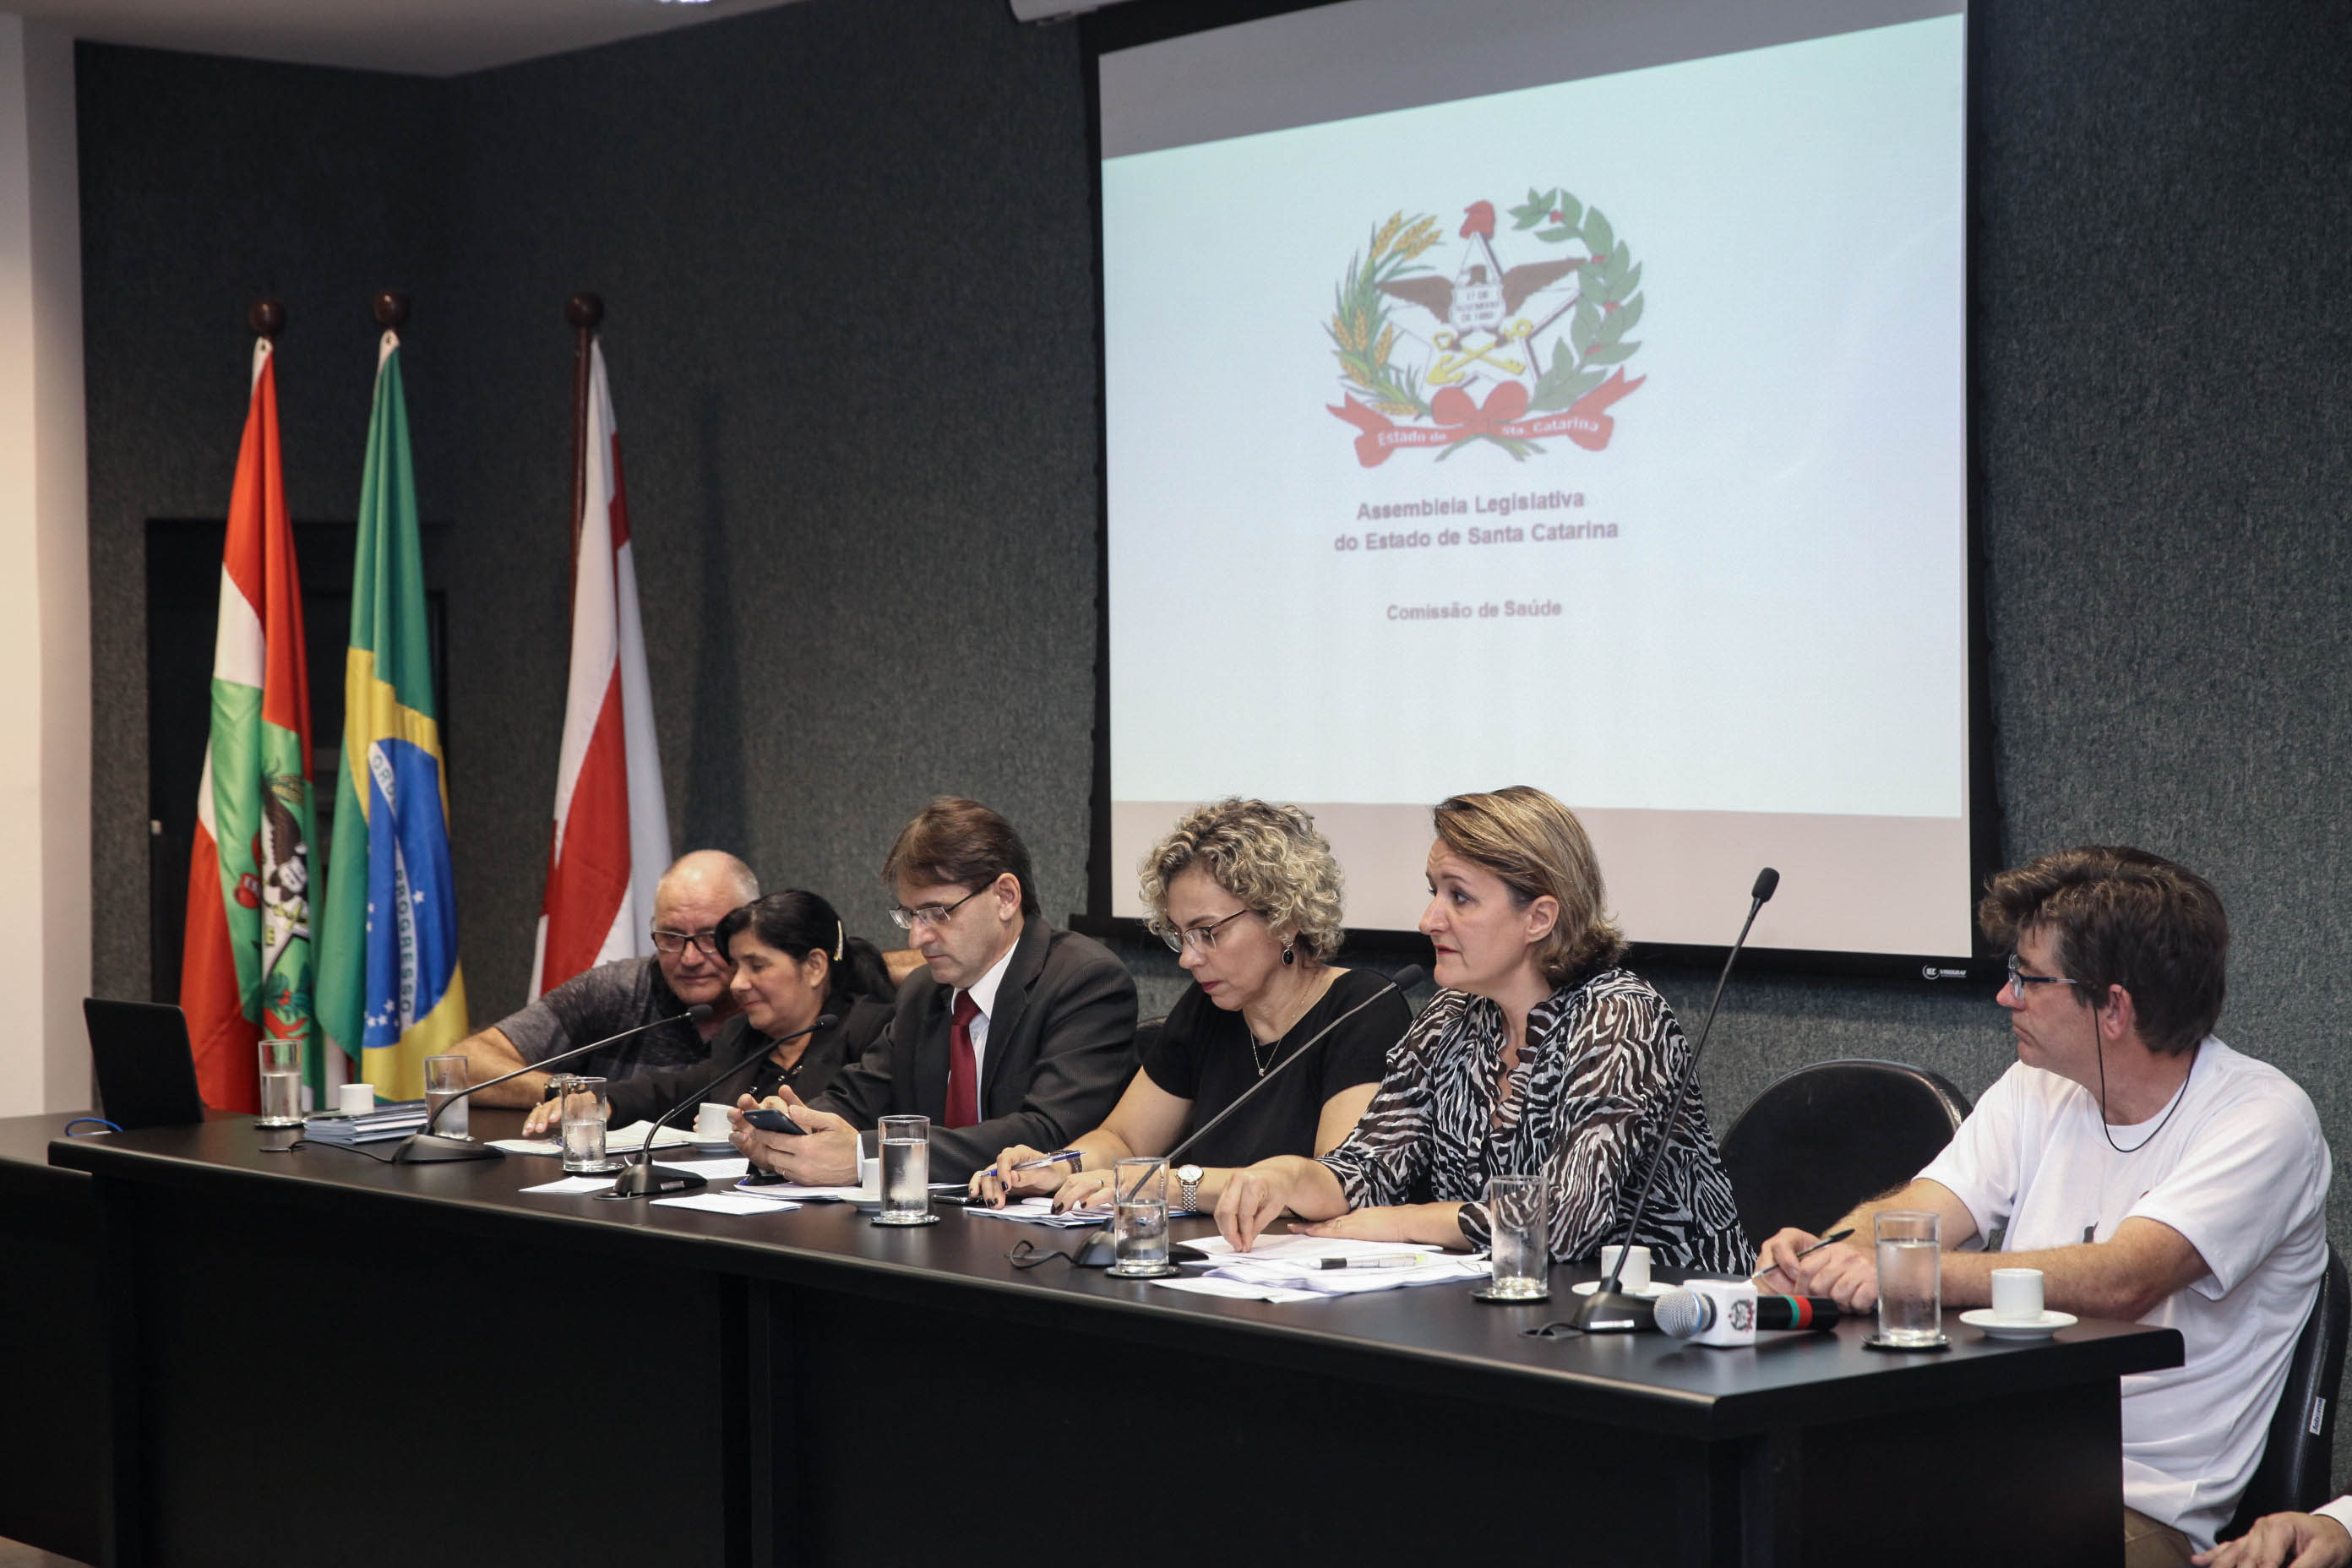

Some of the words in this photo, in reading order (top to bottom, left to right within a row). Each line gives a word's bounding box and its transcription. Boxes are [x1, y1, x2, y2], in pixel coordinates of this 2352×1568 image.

[1357, 497, 1467, 520] Assembleia
[1475, 491, 1585, 515] Legislativa
[1334, 534, 1358, 551] do
[1365, 531, 1431, 551] Estado
[1438, 528, 1461, 546] de
[1467, 525, 1524, 545] Santa
[1531, 520, 1620, 542] Catarina
[1386, 602, 1473, 621] Comissão
[1478, 602, 1500, 618] de
[1504, 598, 1563, 618] Saúde
[396, 868, 414, 1013] PROGRESSO
